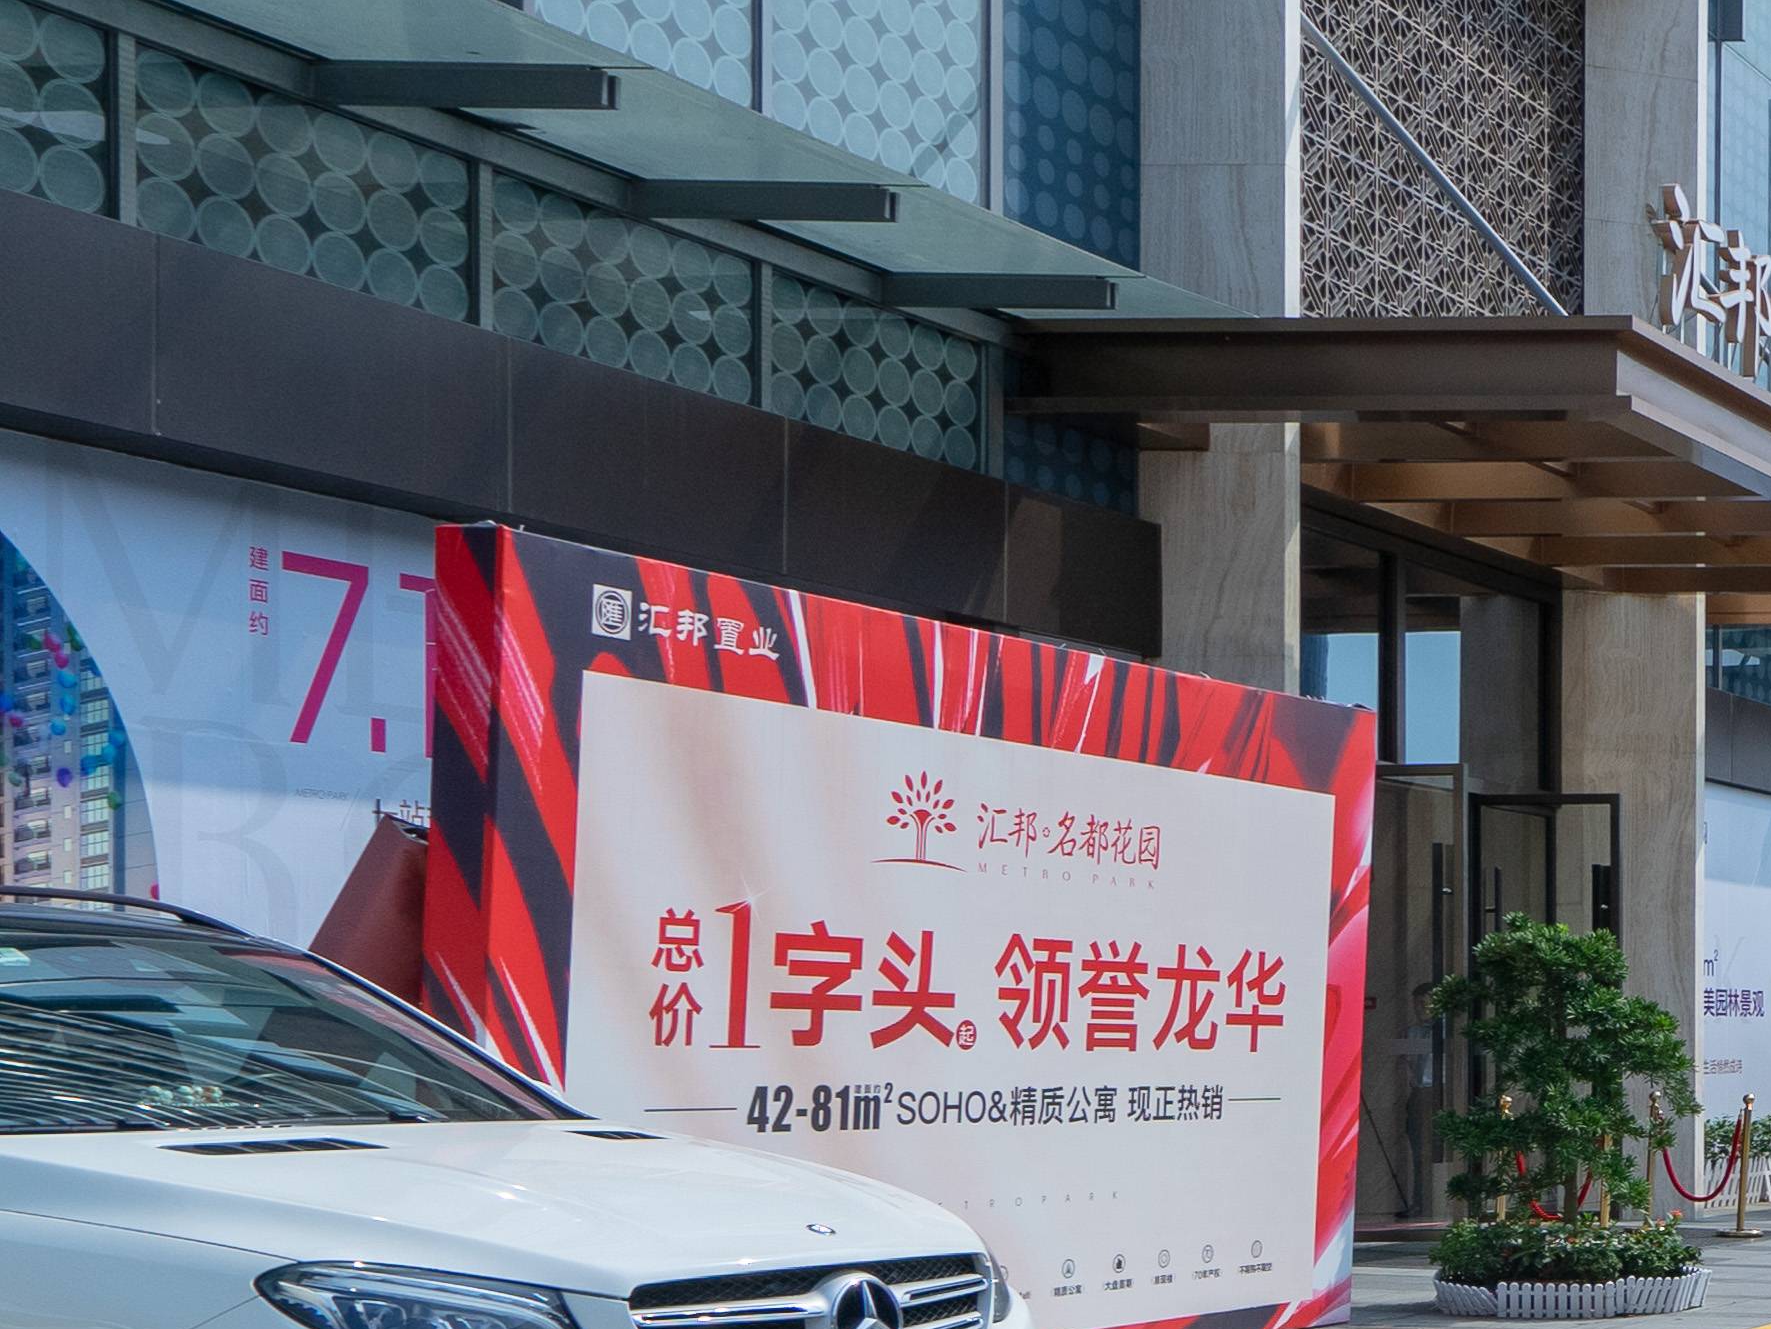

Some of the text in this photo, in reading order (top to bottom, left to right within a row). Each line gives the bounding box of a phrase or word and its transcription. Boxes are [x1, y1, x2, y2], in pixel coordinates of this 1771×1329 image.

[248, 545, 270, 637] 建面约
[637, 601, 780, 662] 汇邦置业
[977, 862, 1157, 890] METRO PARK
[648, 907, 705, 1048] 总价
[993, 932, 1289, 1054] 领誉龙华
[1127, 1083, 1226, 1122] 现正热销
